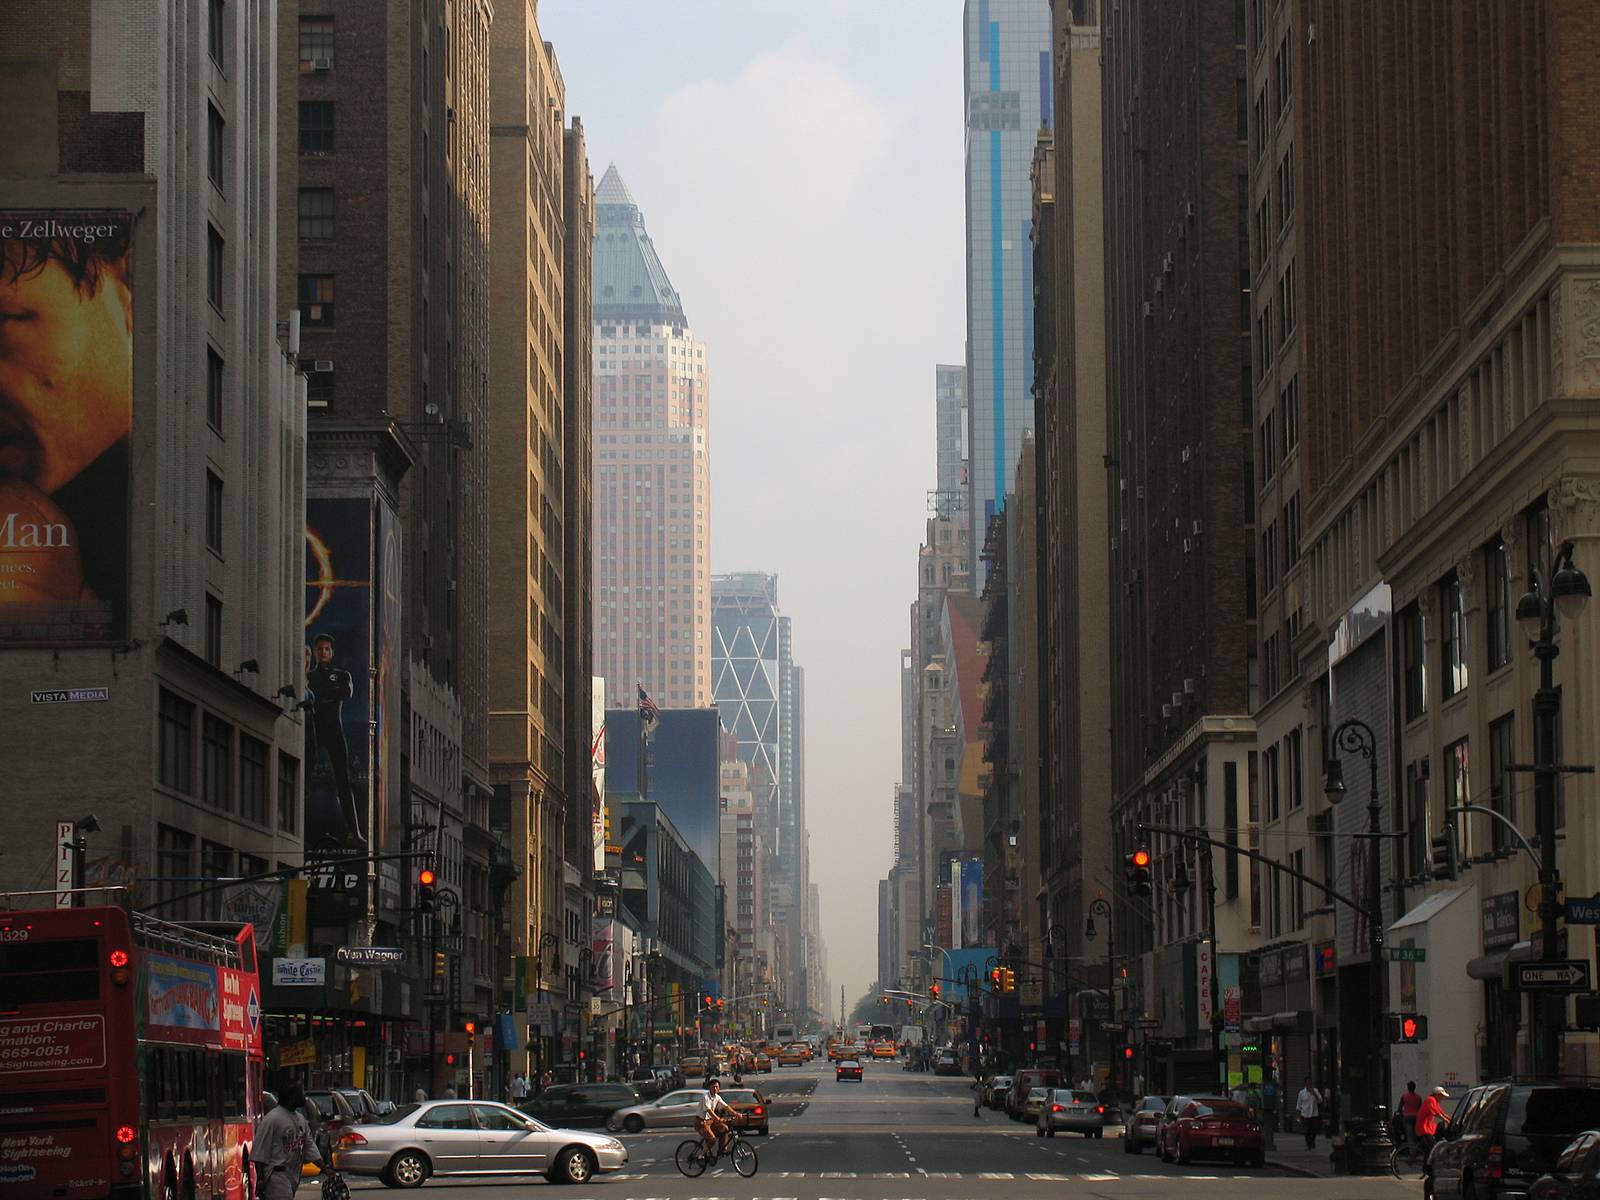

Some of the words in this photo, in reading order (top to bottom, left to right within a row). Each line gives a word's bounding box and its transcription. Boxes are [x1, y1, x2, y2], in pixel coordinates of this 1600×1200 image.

[20, 220, 118, 244] Zellweger
[33, 692, 67, 702] VISTA
[69, 690, 105, 700] MEDIA
[344, 949, 362, 960] Van
[364, 949, 404, 962] Wagner
[1200, 953, 1209, 998] CAFE
[1525, 971, 1544, 980] ONE
[1556, 970, 1576, 979] WAY
[12, 1022, 40, 1034] and
[43, 1020, 98, 1032] Charter
[2, 1138, 28, 1148] New
[30, 1135, 54, 1146] York
[1, 1147, 72, 1161] Sightseeing
